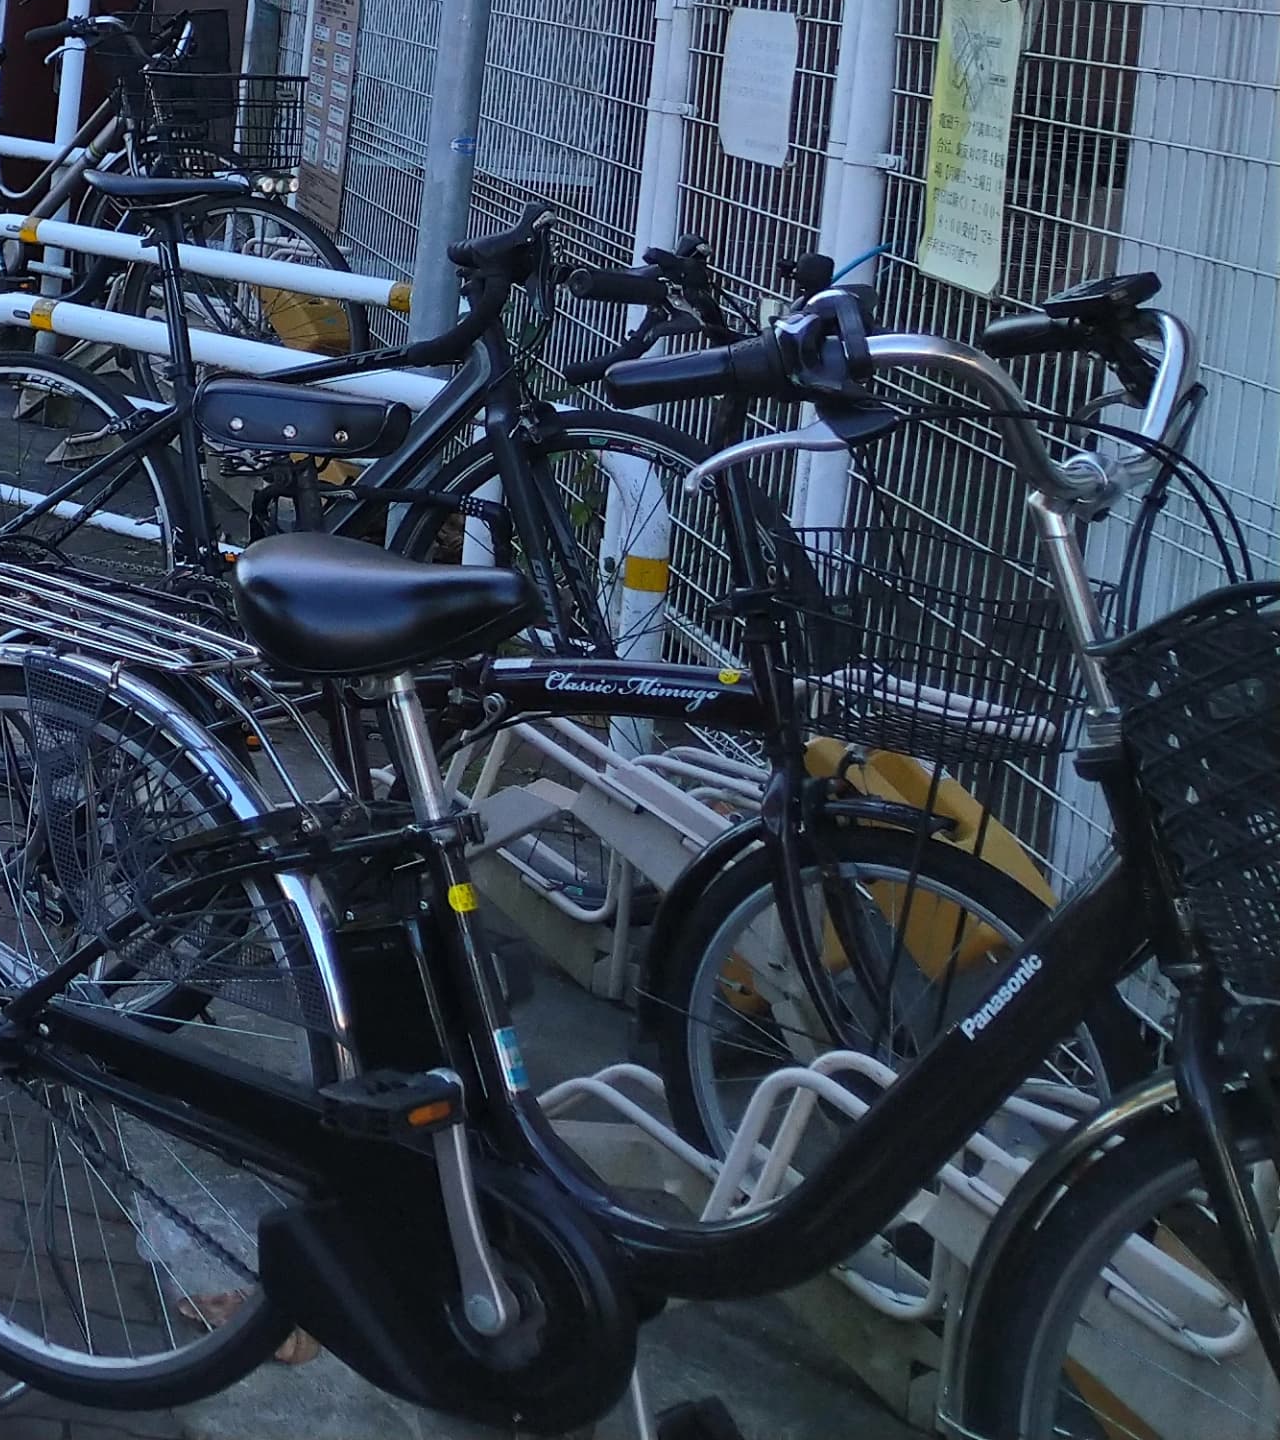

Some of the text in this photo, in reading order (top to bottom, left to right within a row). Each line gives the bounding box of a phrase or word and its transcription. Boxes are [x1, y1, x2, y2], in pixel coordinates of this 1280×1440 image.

[544, 670, 722, 712] Classic Mimugo
[960, 954, 1042, 1041] Panasonic
